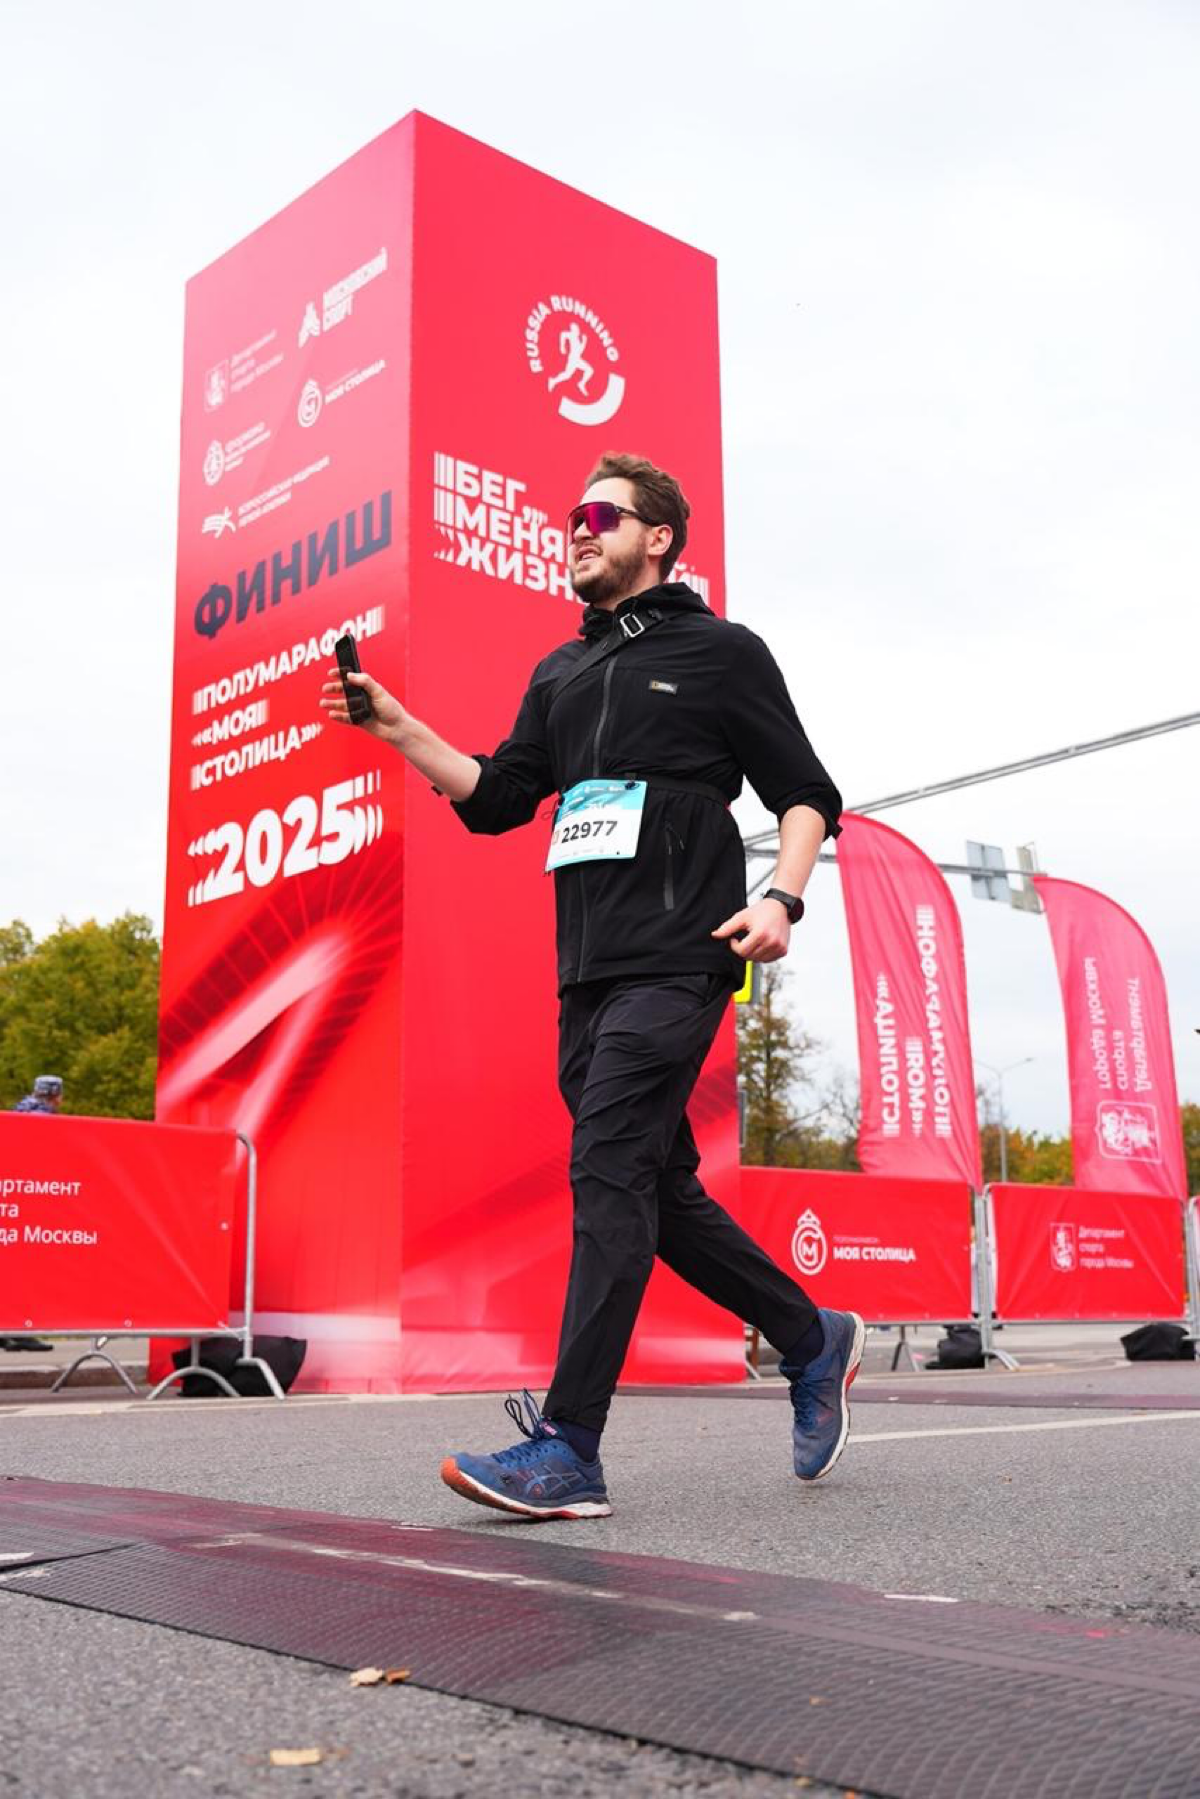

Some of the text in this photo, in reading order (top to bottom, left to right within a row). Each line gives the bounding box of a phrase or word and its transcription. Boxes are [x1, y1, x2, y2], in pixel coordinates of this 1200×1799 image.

[524, 301, 551, 373] RUSSIA
[194, 490, 392, 640] ФИНИШ
[456, 530, 590, 606] ЖИЗН
[199, 607, 376, 709] ПОЛУМАРАФОН
[196, 775, 372, 905] 2025
[561, 820, 618, 844] 22977
[0, 1179, 81, 1198] ртамент
[24, 1225, 97, 1245] Москвы
[833, 1246, 917, 1264] МОЯ СТОЛИЦА
